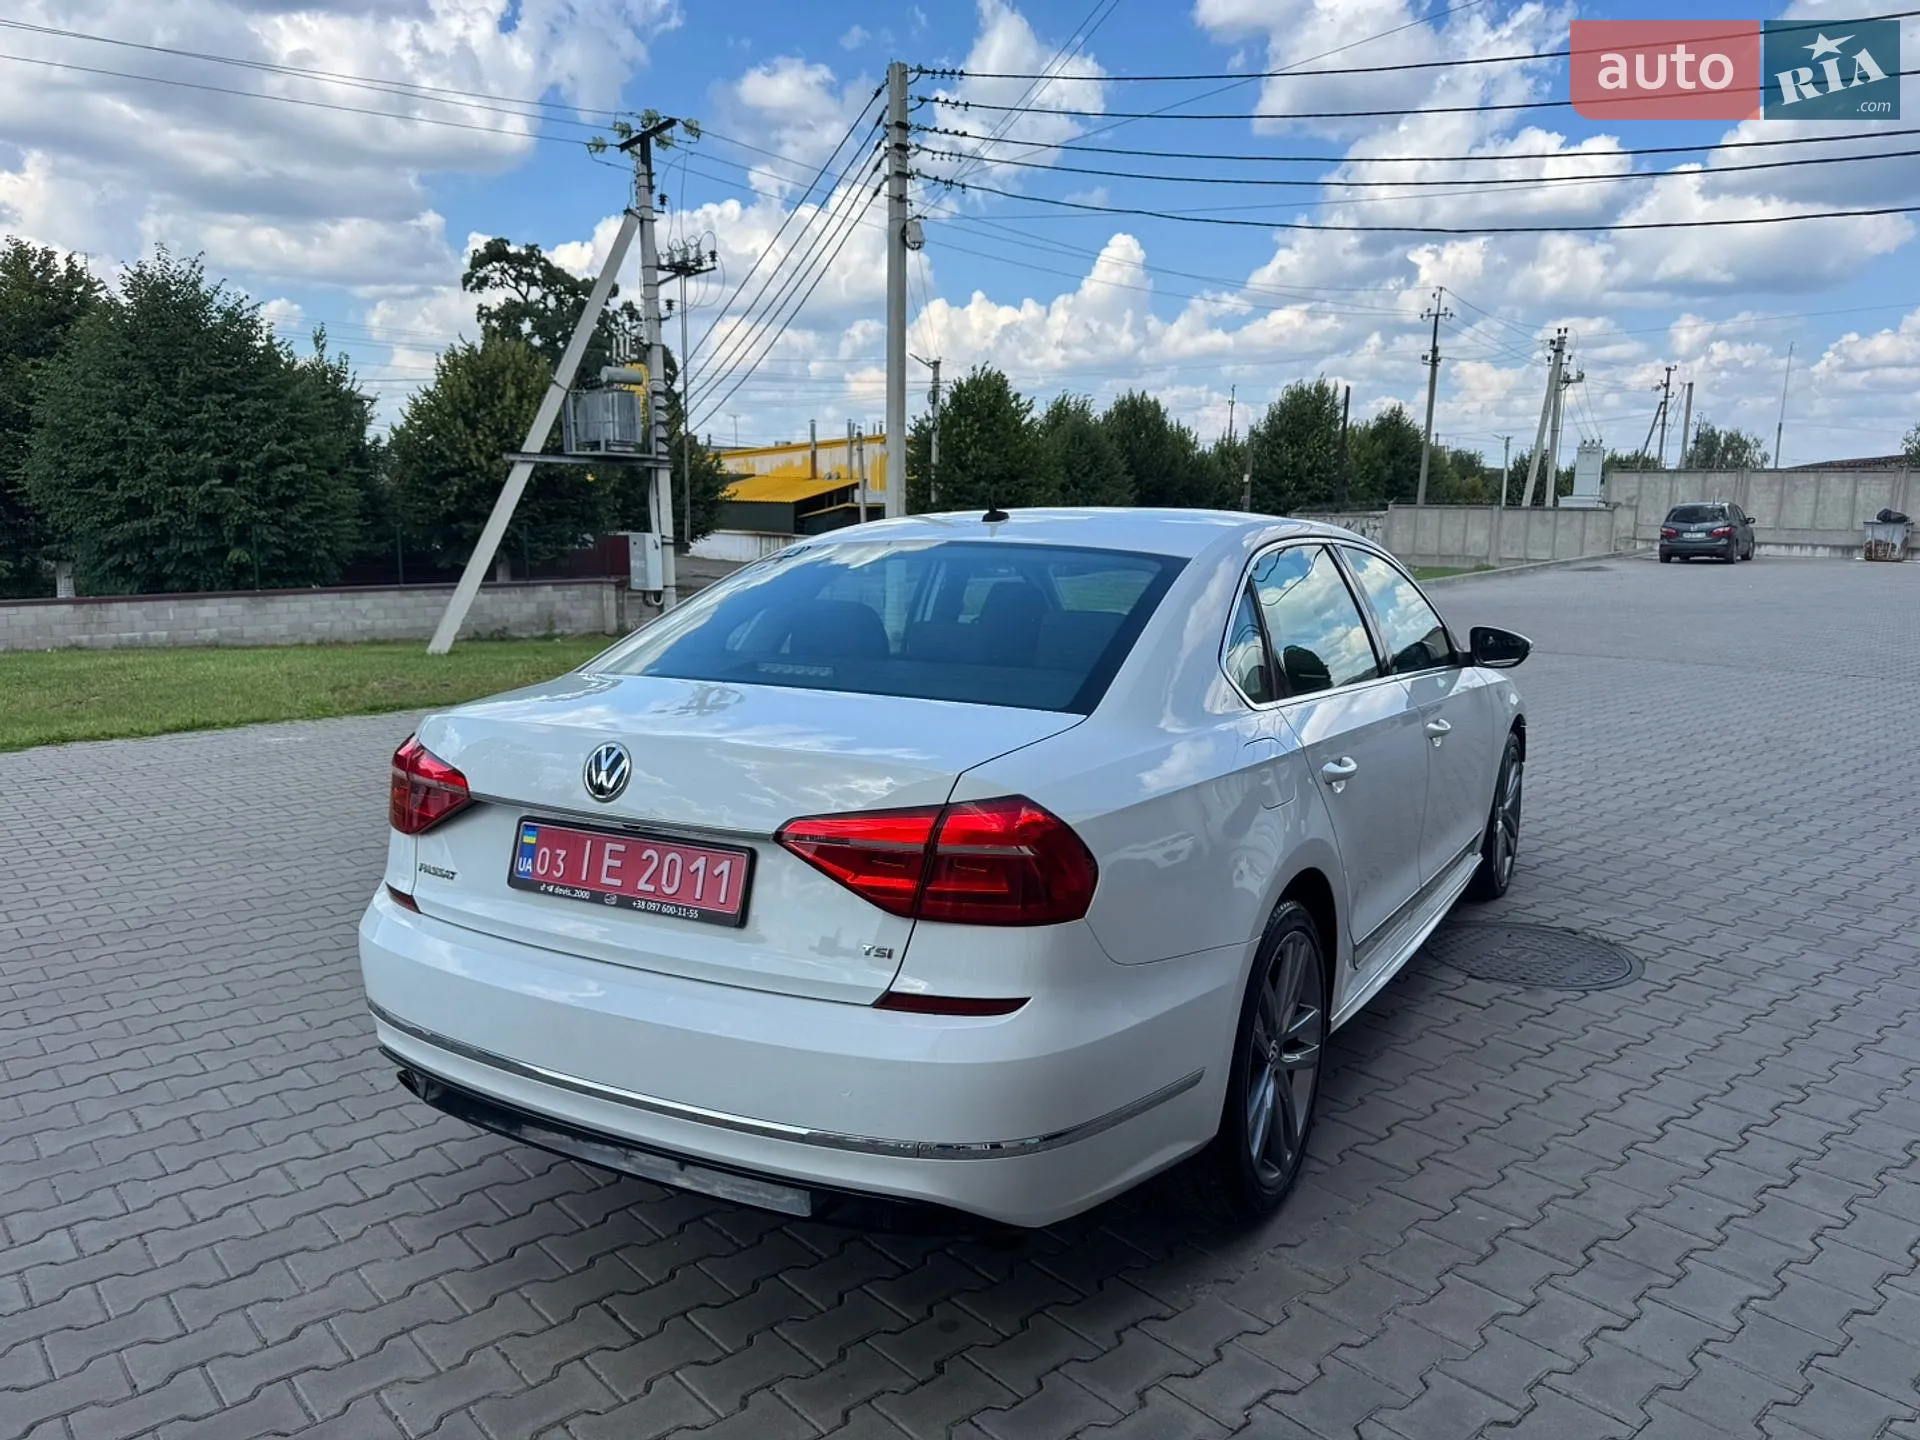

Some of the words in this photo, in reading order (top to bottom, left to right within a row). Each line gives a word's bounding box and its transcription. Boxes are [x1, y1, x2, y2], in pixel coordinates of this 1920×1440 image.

[518, 856, 533, 873] UA
[537, 847, 567, 878] 03
[581, 839, 626, 887] IE
[637, 849, 733, 904] 2011
[862, 943, 895, 960] TSI
